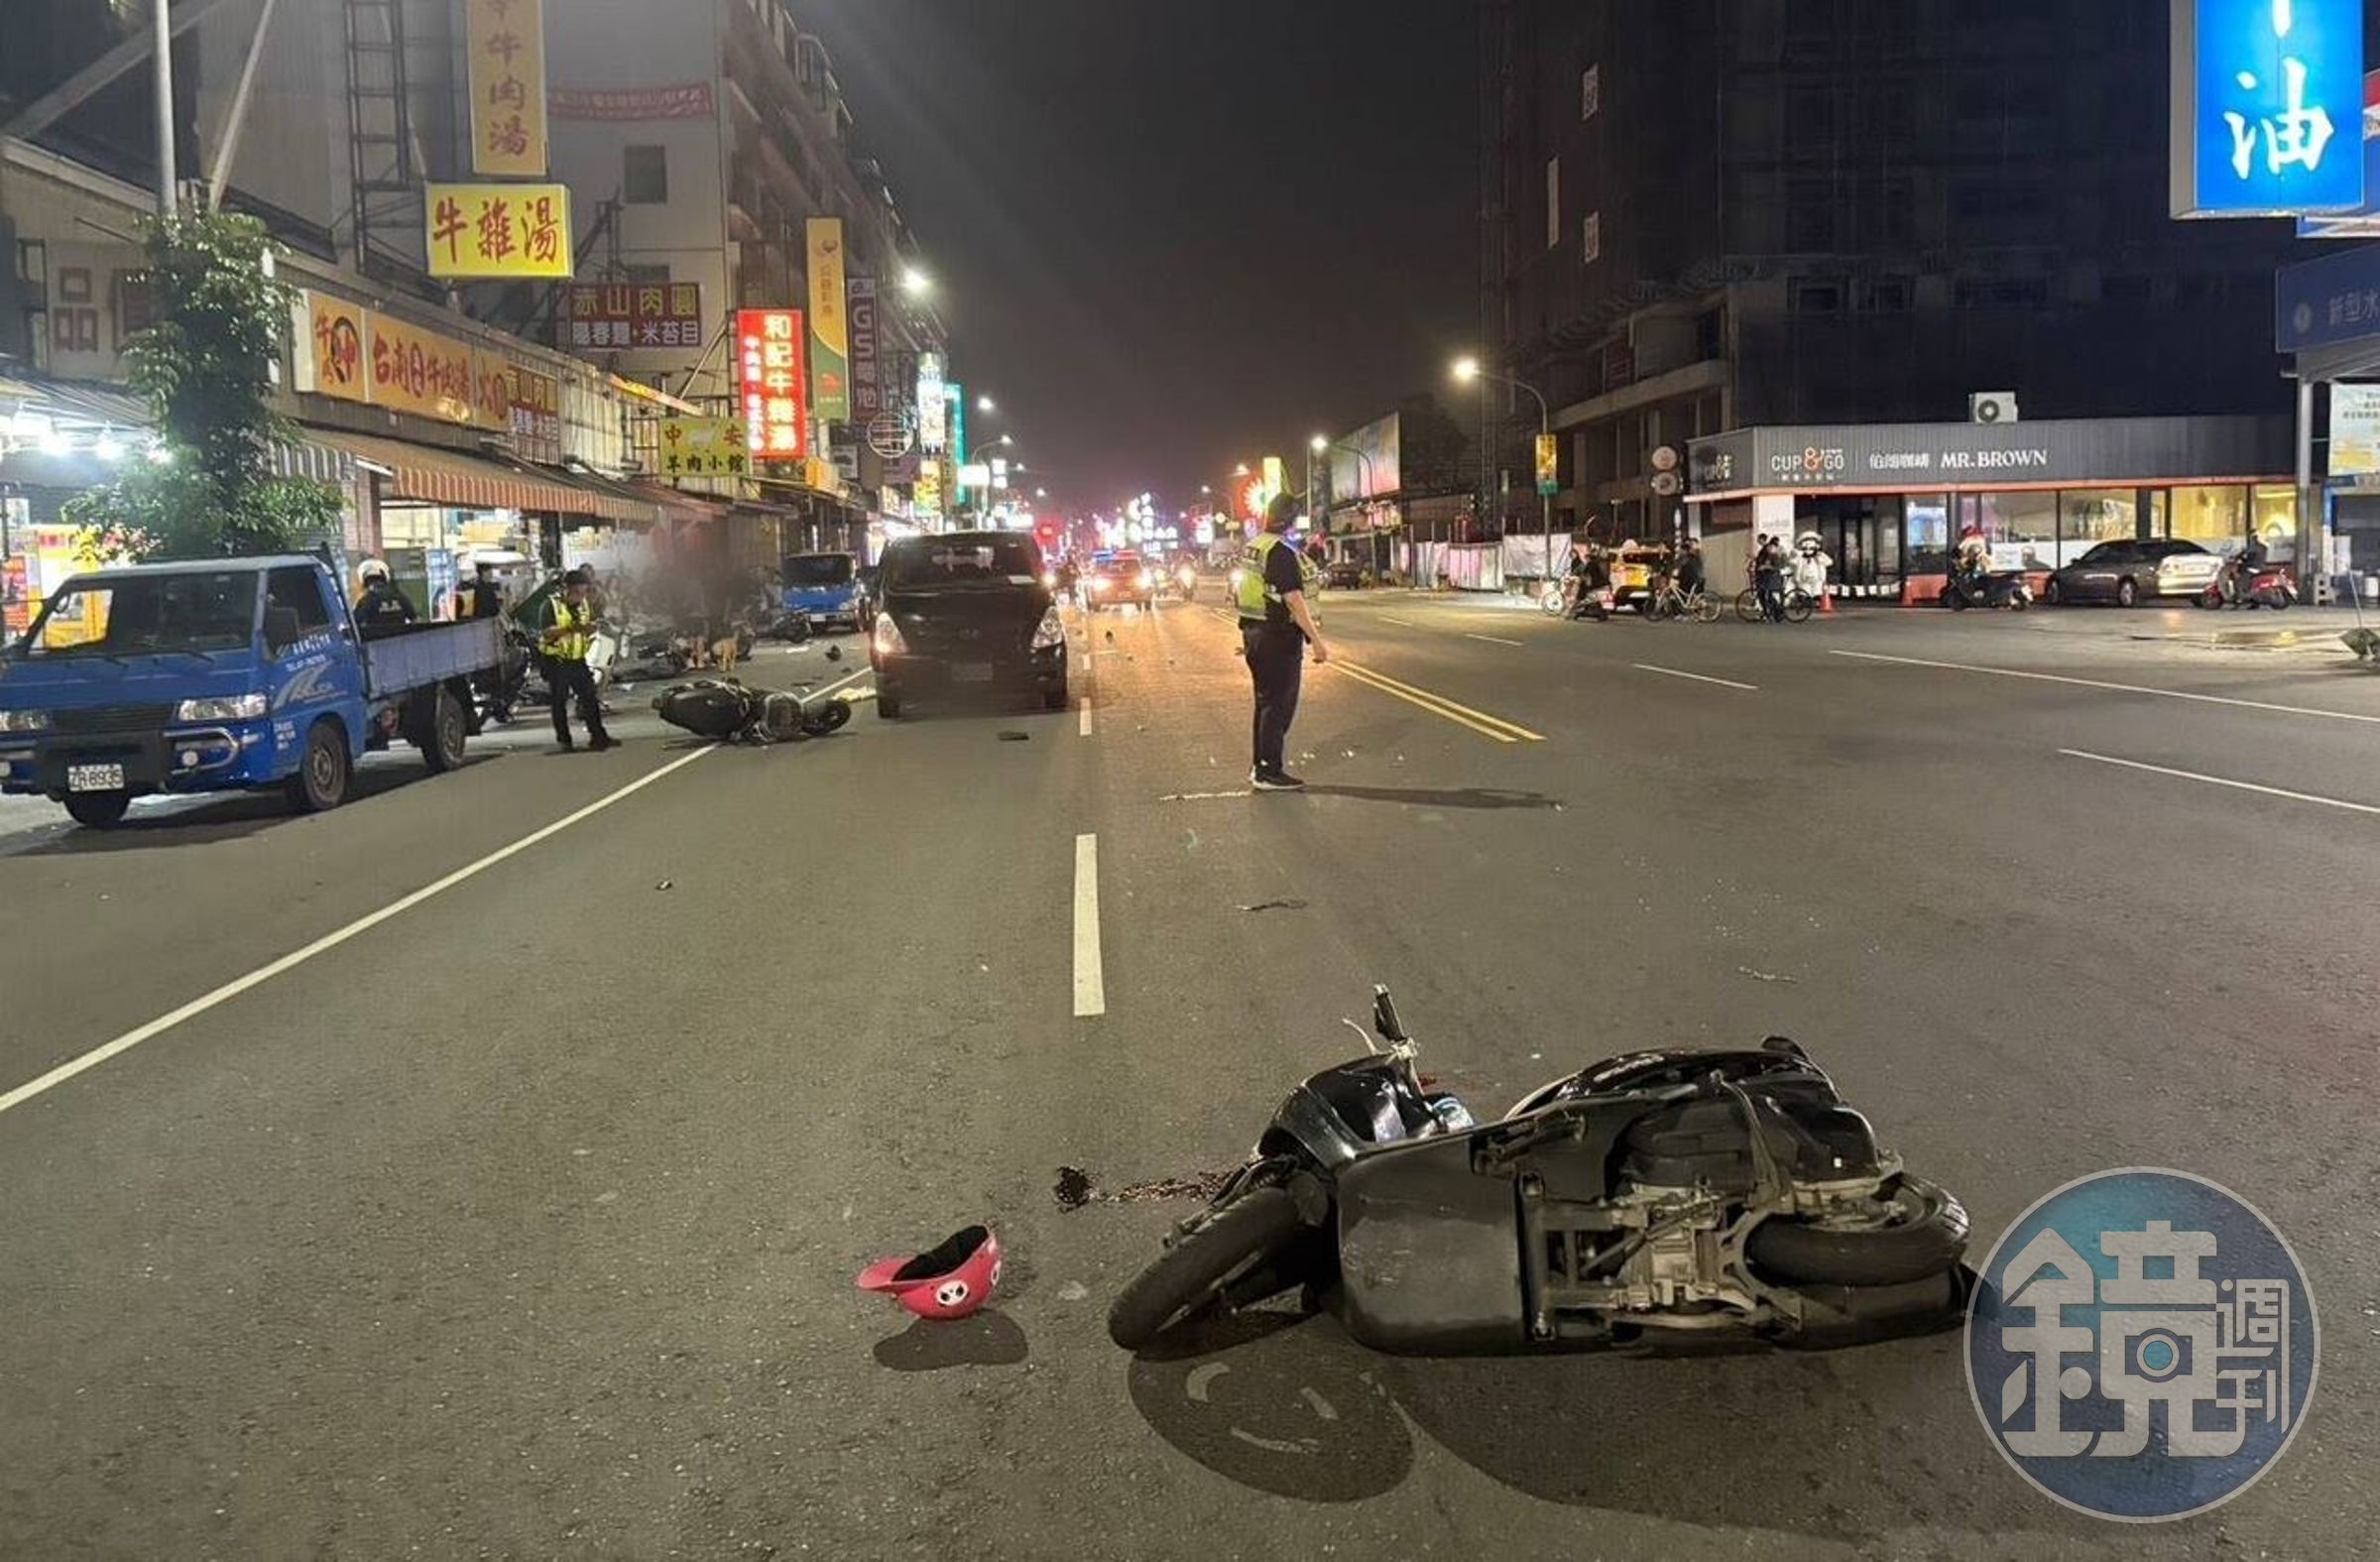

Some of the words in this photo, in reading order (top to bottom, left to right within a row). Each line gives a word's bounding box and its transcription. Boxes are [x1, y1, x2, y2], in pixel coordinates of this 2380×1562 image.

[486, 0, 530, 156] 牛肉湯
[2223, 0, 2334, 180] 油
[432, 196, 557, 264] 牛雜湯
